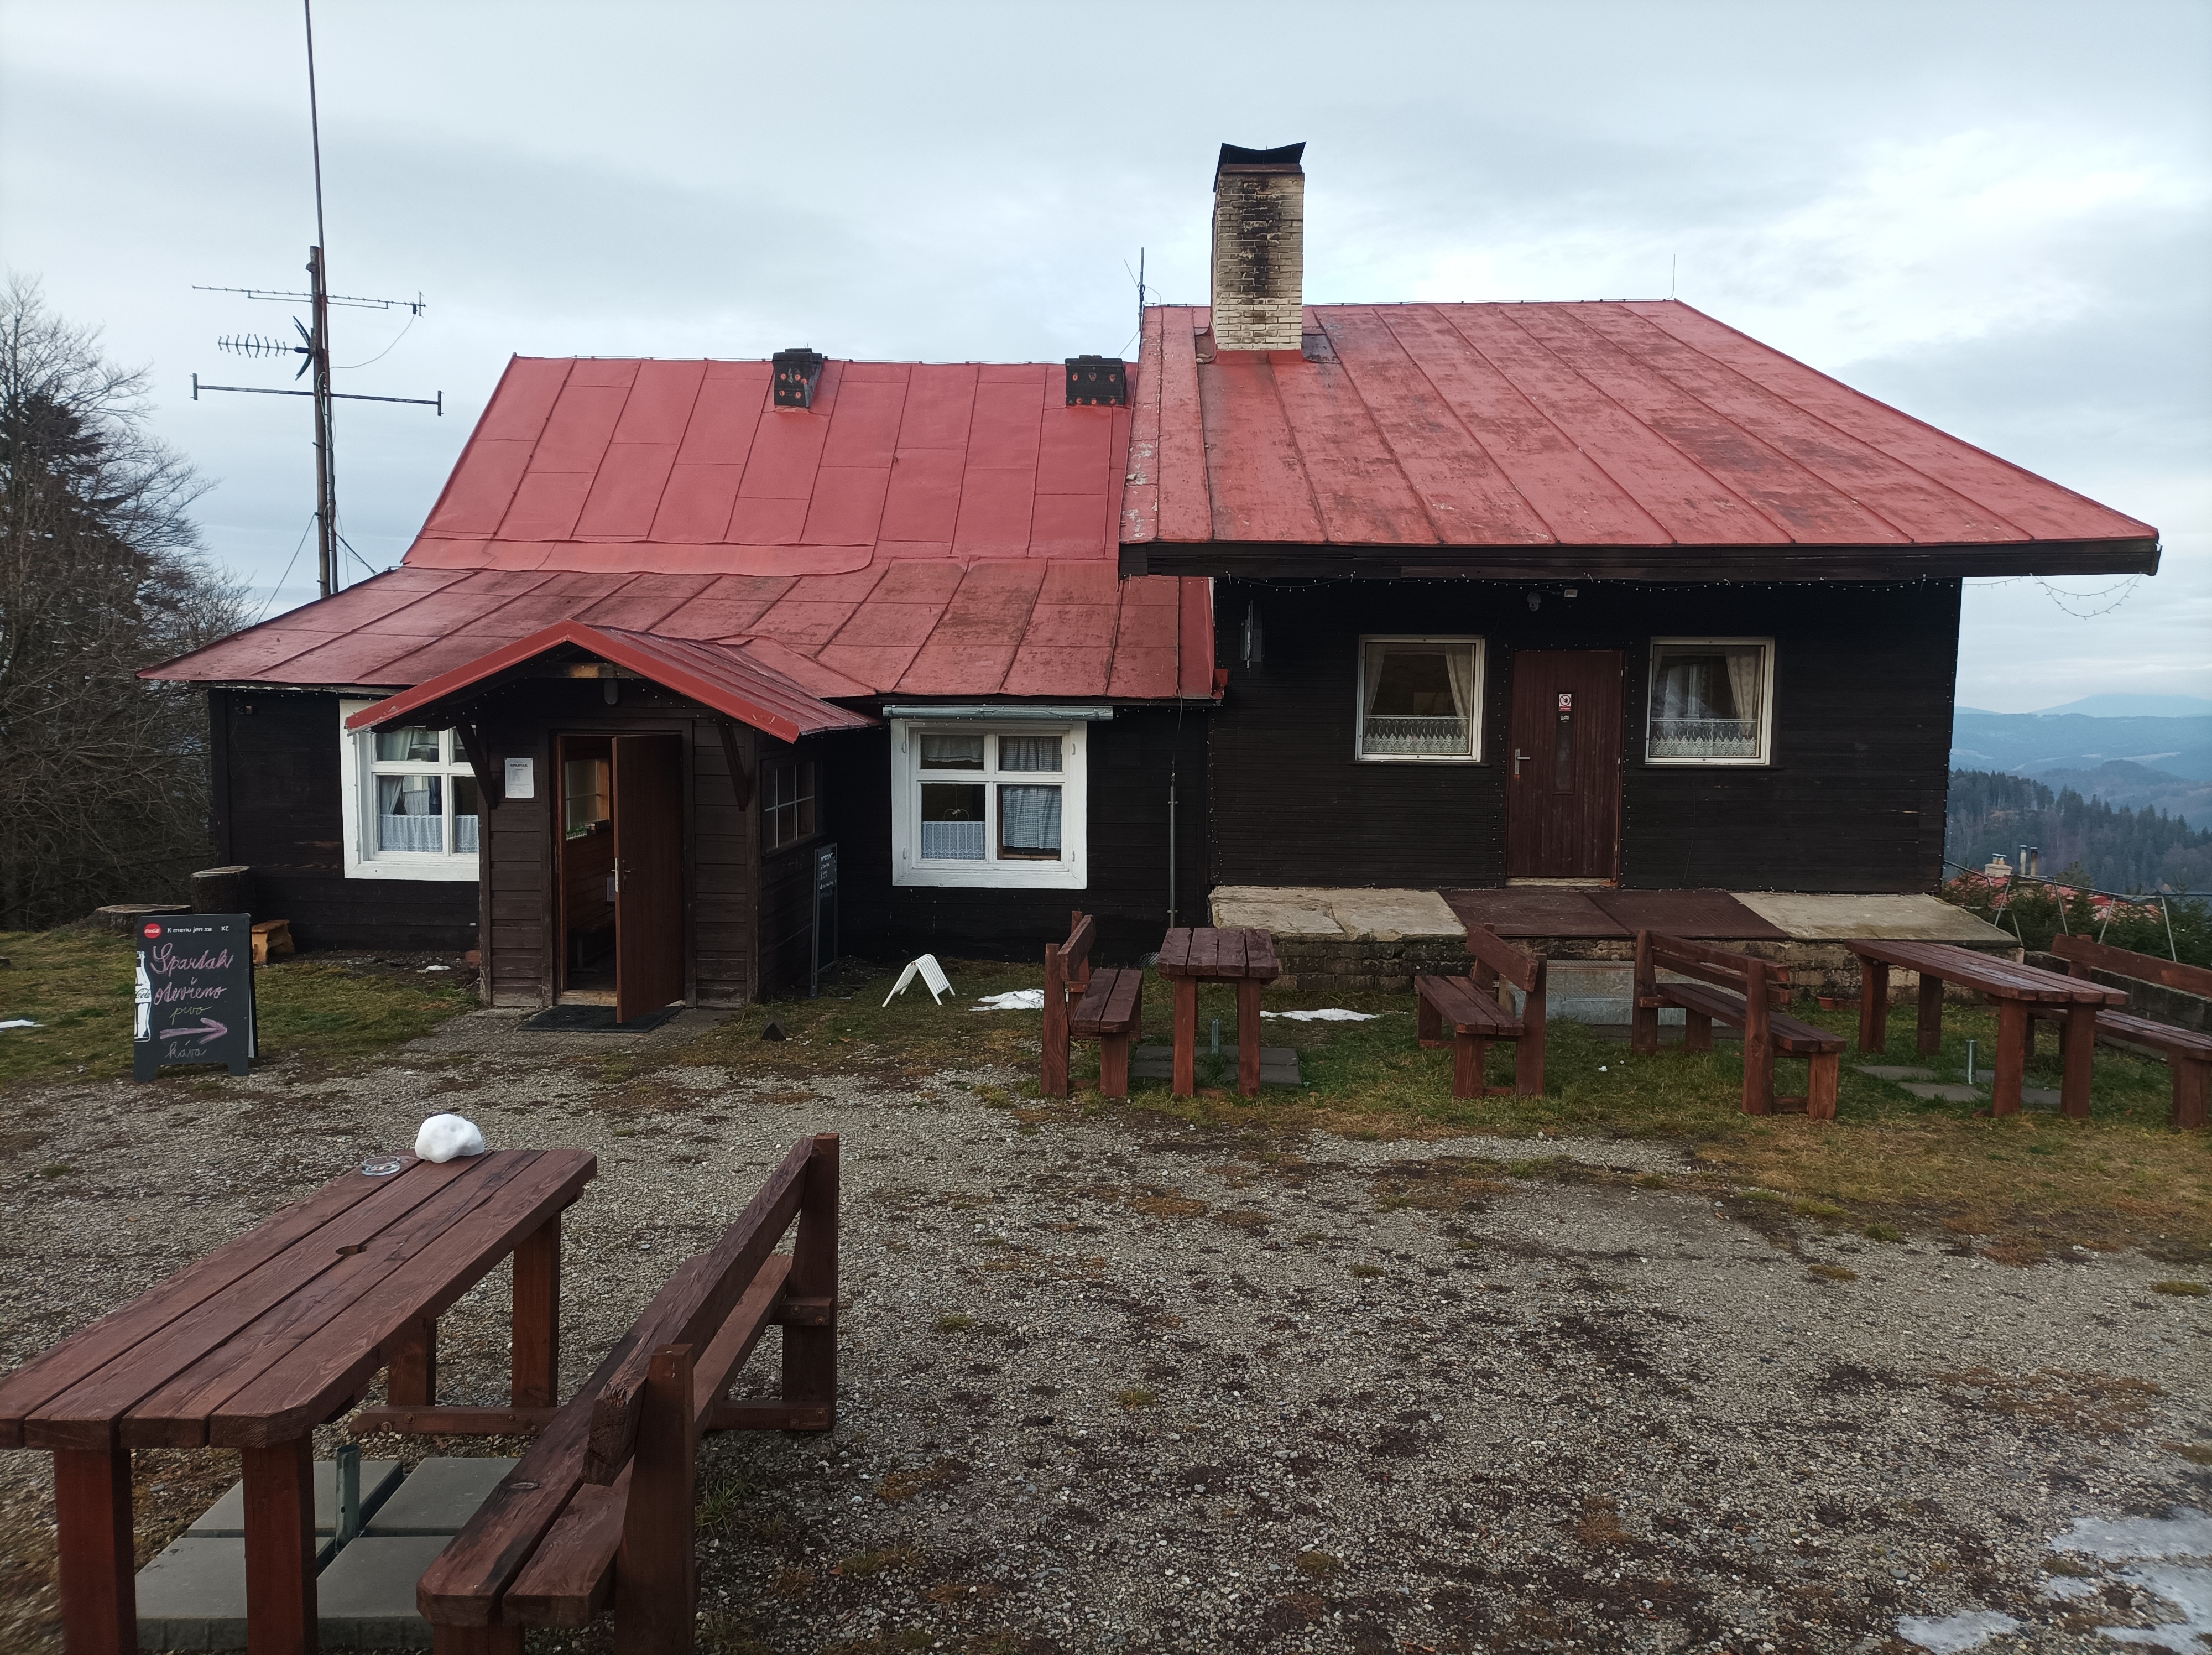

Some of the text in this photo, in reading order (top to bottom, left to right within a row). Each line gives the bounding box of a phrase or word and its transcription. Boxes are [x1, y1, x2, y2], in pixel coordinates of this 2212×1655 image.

[150, 943, 234, 977] Spartak
[154, 977, 227, 1005] otevřeno
[169, 1006, 212, 1026] pivo
[164, 1040, 207, 1059] káva
